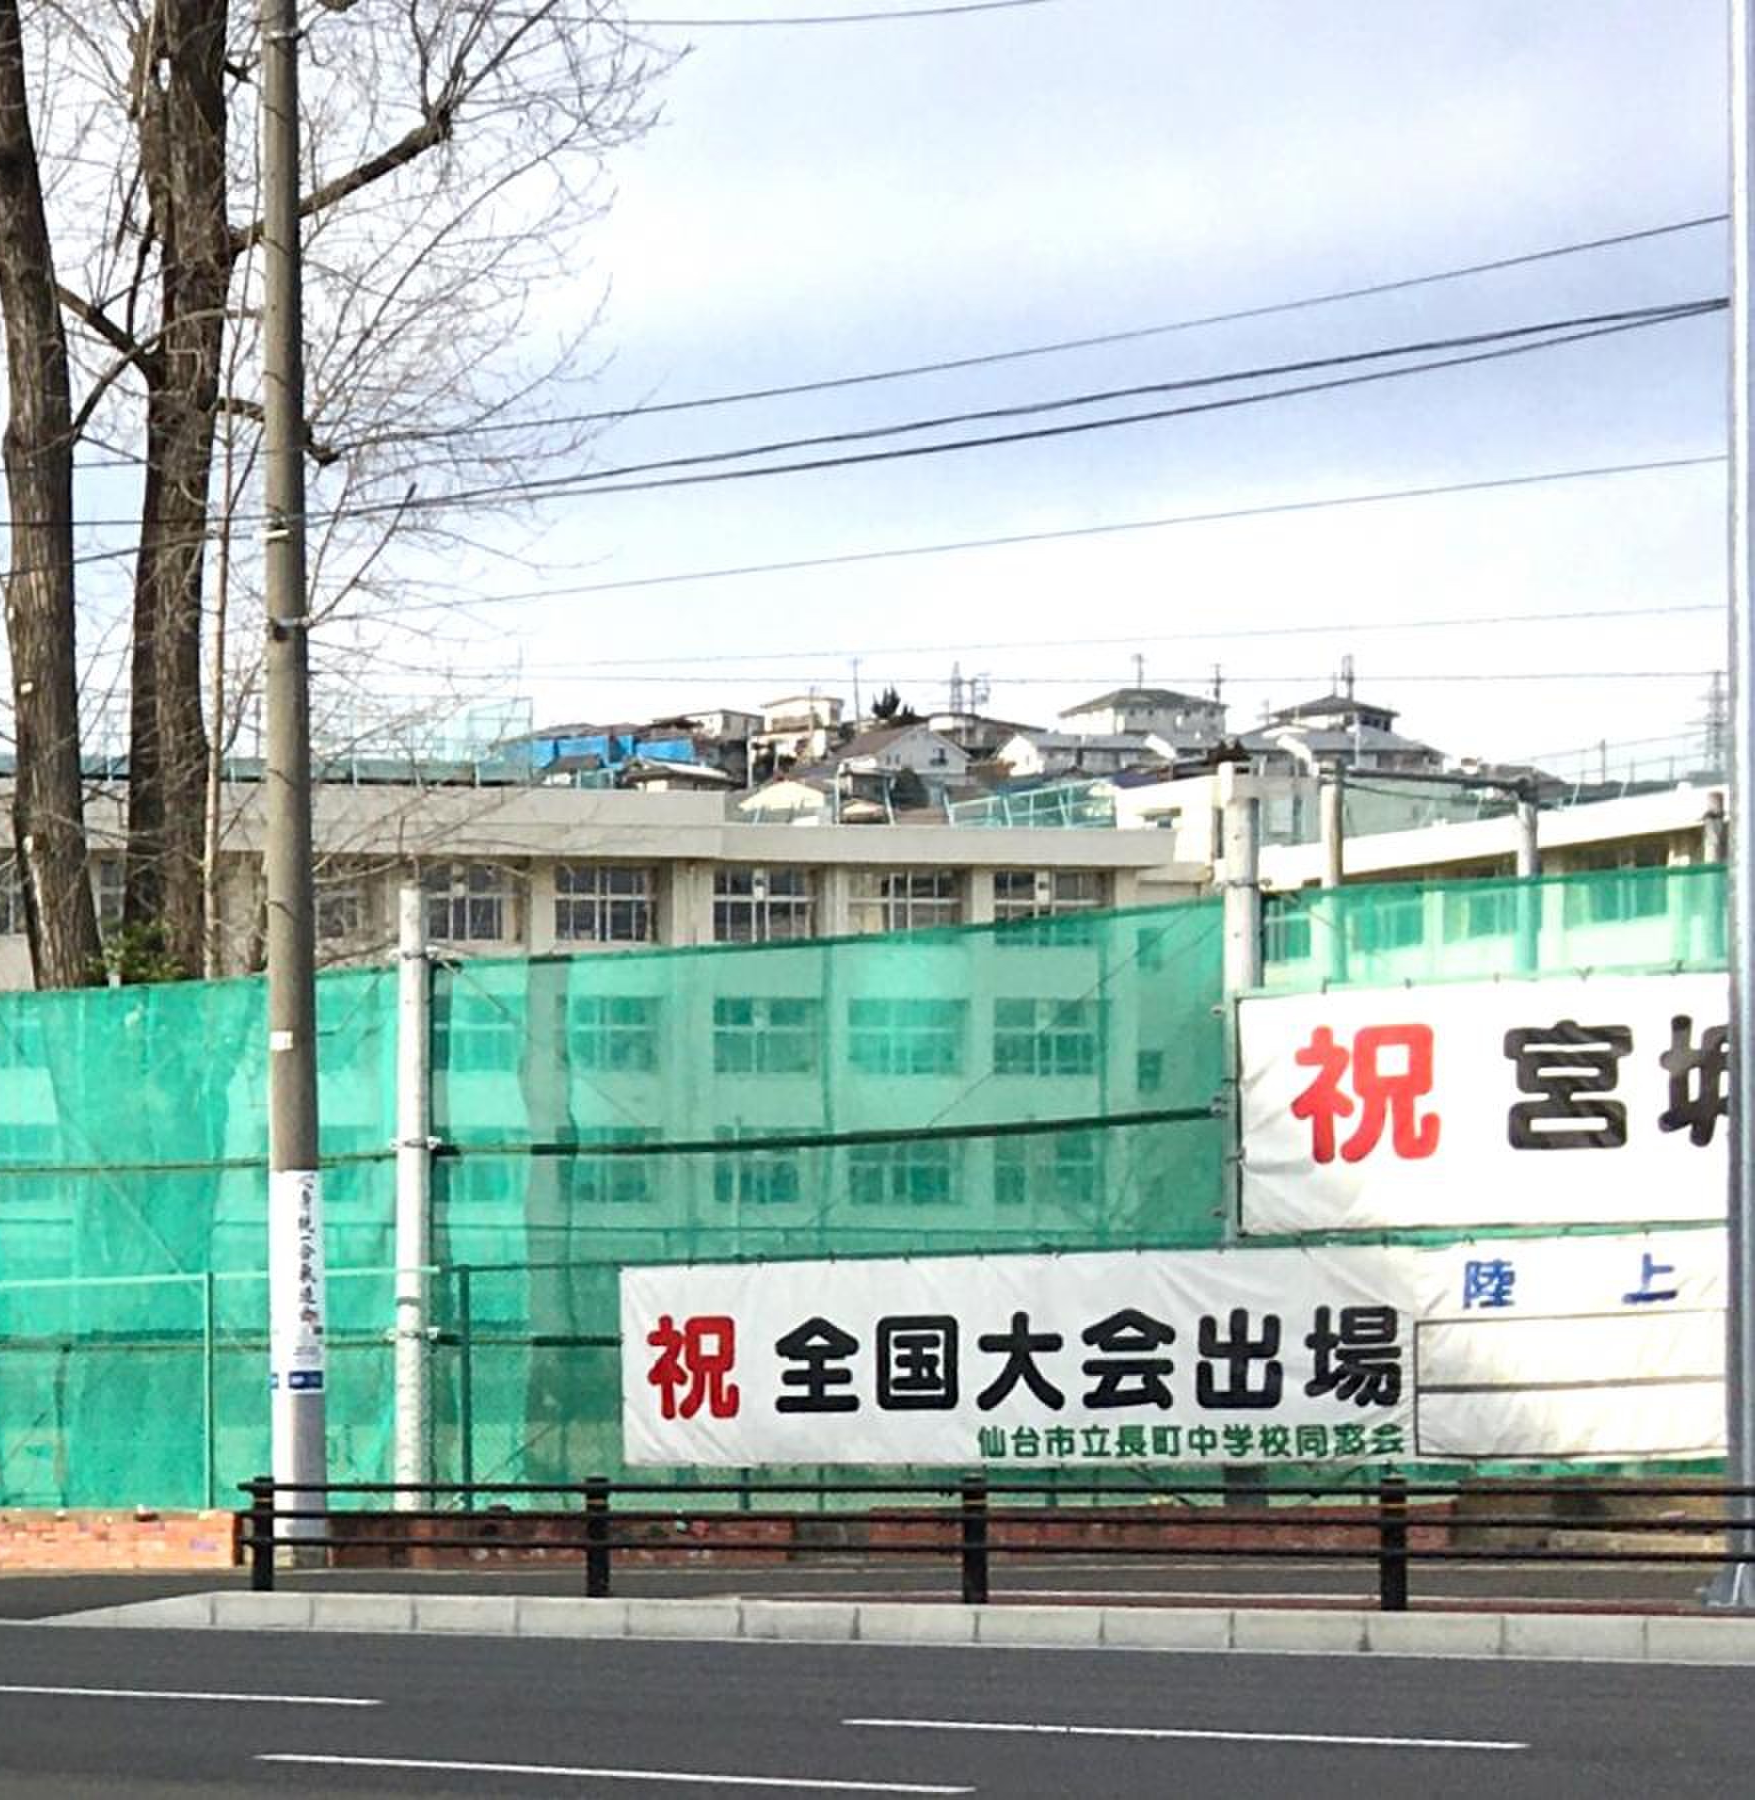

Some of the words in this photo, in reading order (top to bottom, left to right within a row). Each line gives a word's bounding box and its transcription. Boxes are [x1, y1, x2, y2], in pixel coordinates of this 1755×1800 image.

[1290, 1022, 1441, 1165] 祝
[646, 1314, 741, 1419] 祝
[774, 1305, 1404, 1414] 全国大会出場
[976, 1423, 1405, 1458] 仙台市立長町中学校同窓会
